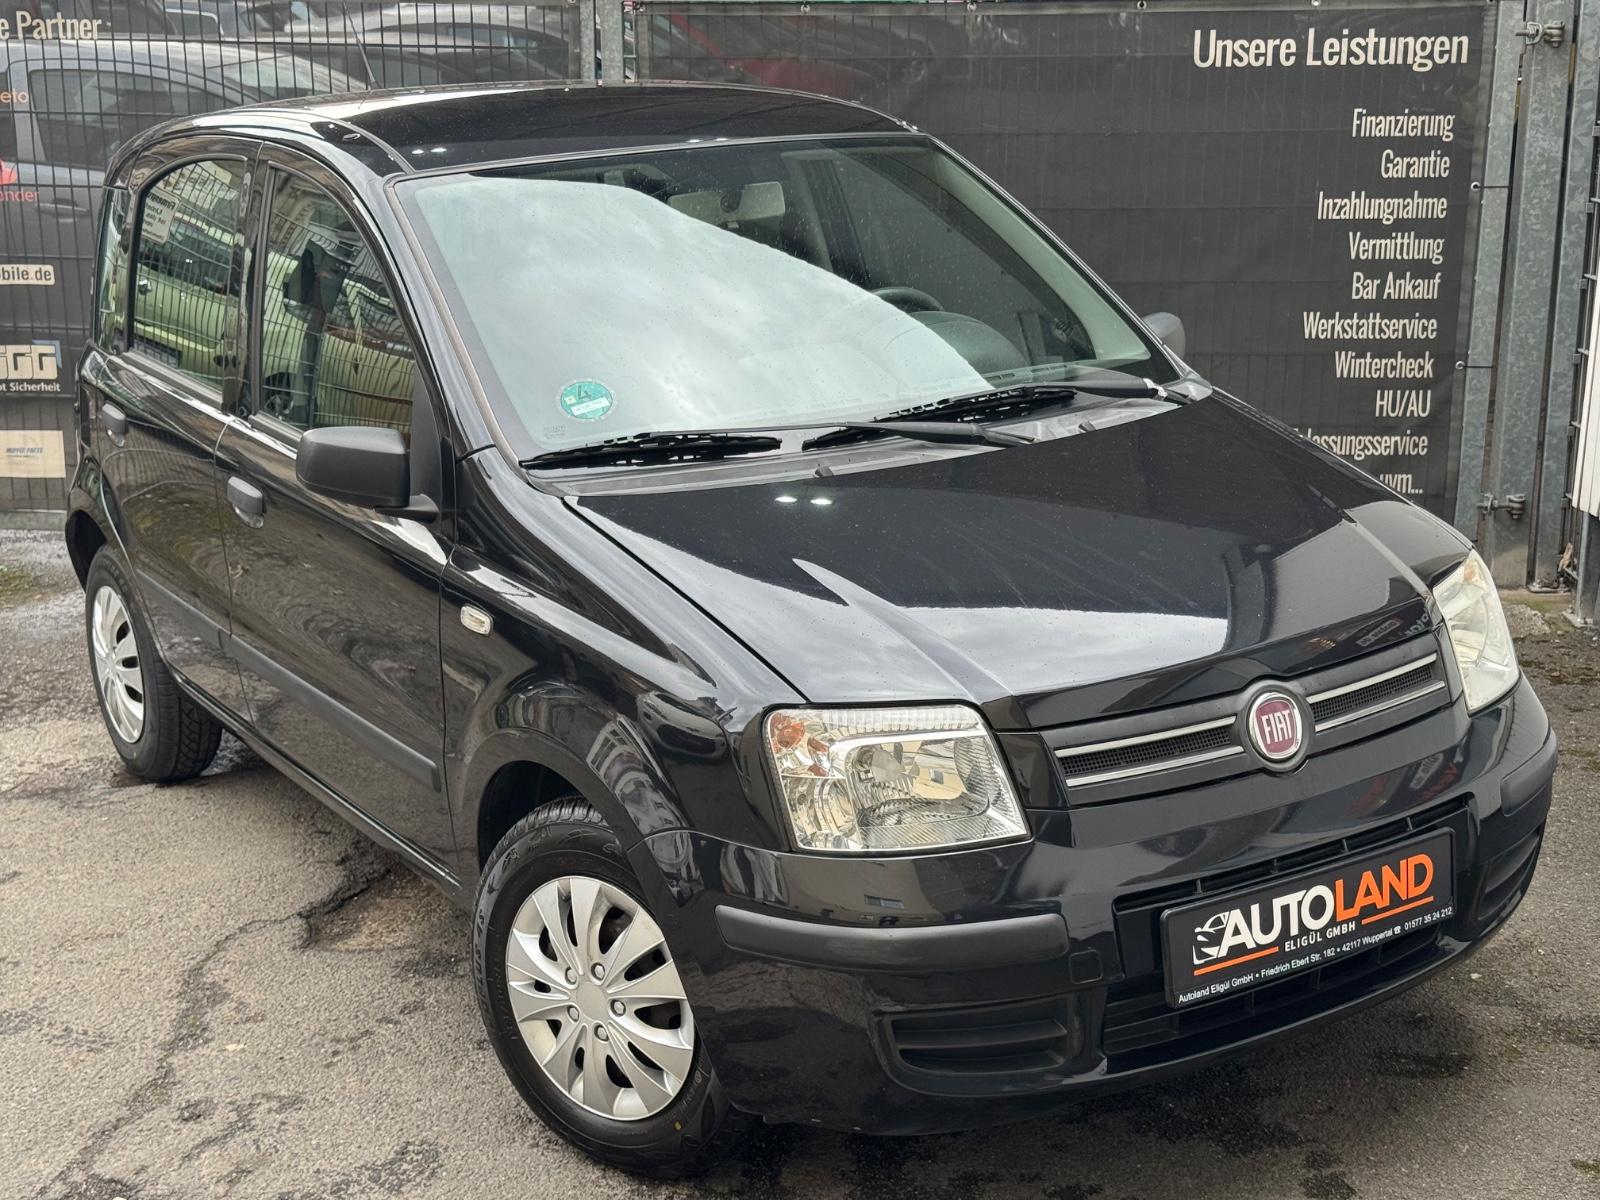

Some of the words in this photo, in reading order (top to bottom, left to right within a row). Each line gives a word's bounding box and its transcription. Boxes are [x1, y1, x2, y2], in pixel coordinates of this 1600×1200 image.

[16, 10, 102, 40] Partner
[1193, 29, 1296, 68] Unsere
[1306, 27, 1469, 72] Leistungen
[1352, 107, 1455, 141] Finanzierung
[1380, 149, 1450, 179] Garantie
[1317, 191, 1448, 224] Inzahlungnahme
[1348, 231, 1445, 264] Vermittlung
[0, 266, 52, 281] bile.de
[1352, 271, 1380, 299] Bar
[1383, 271, 1441, 299] Ankauf
[1303, 311, 1437, 340] Werkstattservice
[1335, 350, 1434, 379] Wintercheck
[10, 382, 61, 392] Sicherheit
[1375, 389, 1432, 417] HU/AU
[1261, 709, 1292, 744] FIAT
[1285, 931, 1322, 952] ELIGÜL
[1326, 920, 1356, 939] GMBH
[1178, 986, 1209, 1003] Autoland
[1231, 973, 1254, 987] GmbH
[1261, 962, 1290, 978] Friedrich
[1291, 957, 1309, 969] Ebert
[1310, 952, 1322, 962] Str.
[1323, 947, 1335, 958] 182
[1342, 939, 1360, 951] 42117
[1362, 929, 1393, 945] Wuppertal
[1404, 917, 1422, 930] 01577
[1441, 906, 1452, 917] 212
